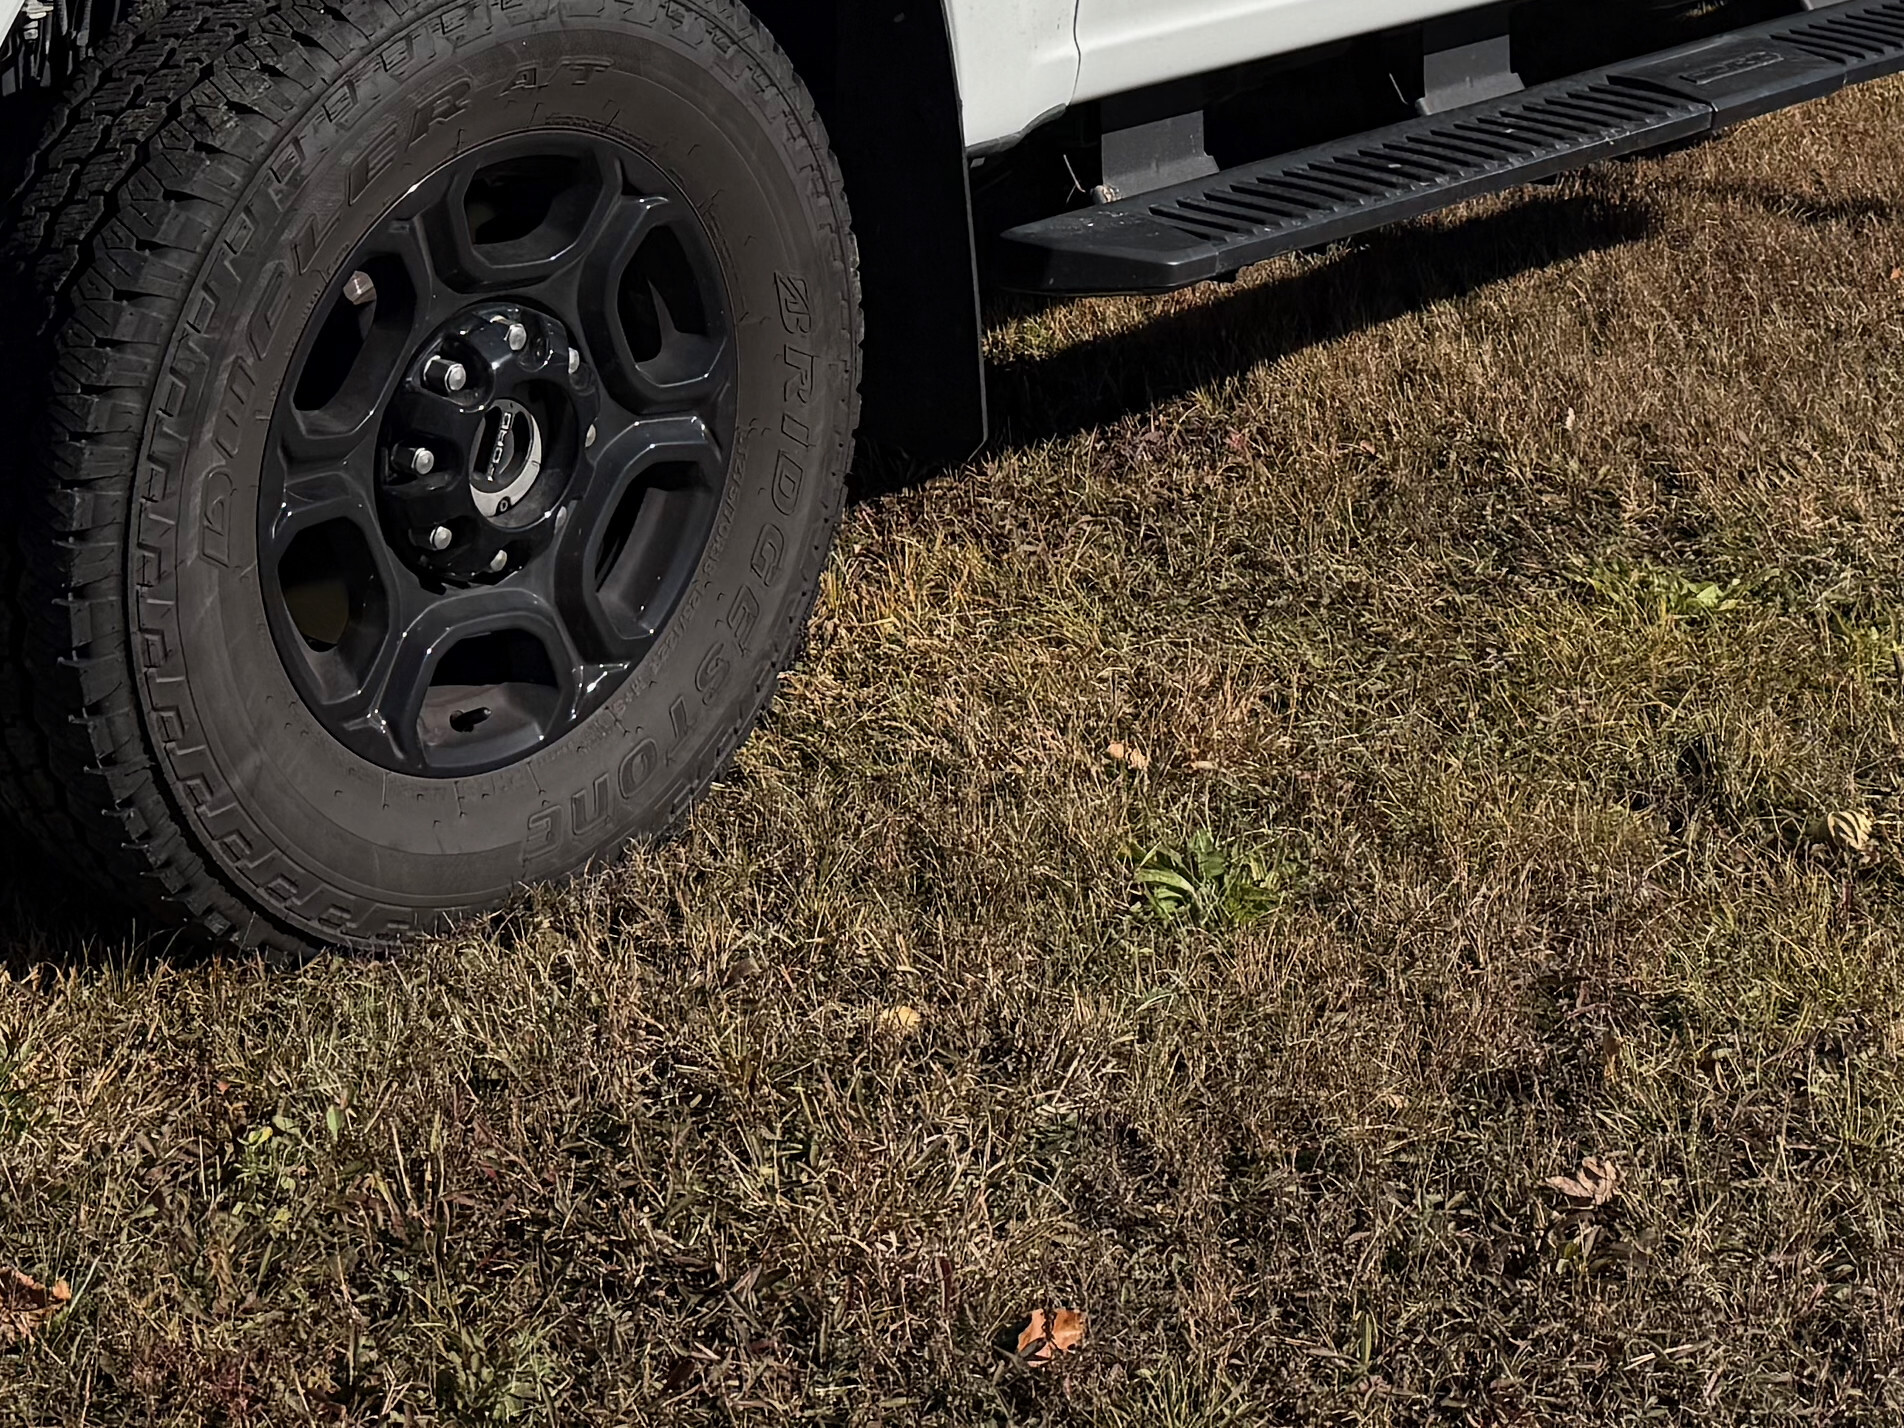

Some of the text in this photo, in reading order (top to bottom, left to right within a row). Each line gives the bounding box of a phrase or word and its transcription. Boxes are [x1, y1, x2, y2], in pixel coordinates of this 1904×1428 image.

[199, 52, 618, 568] DUELER A/T
[515, 266, 818, 866] BRIDGESTONE
